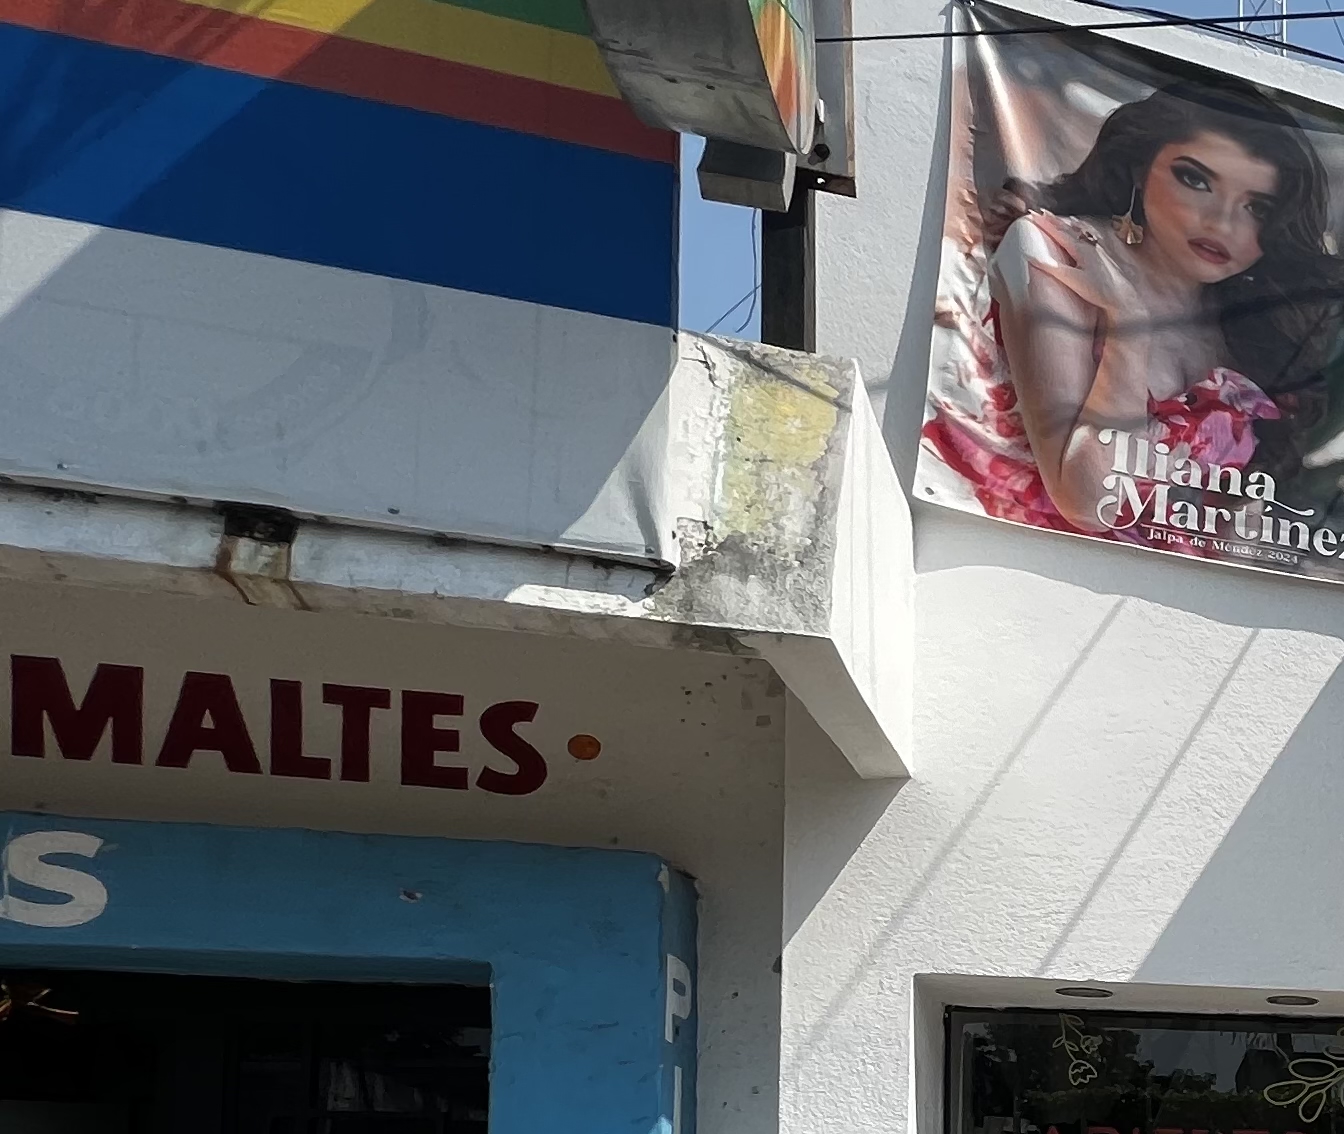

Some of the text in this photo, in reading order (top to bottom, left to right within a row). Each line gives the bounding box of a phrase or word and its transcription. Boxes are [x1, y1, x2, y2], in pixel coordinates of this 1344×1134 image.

[1098, 428, 1315, 517] Iliana
[1147, 528, 1184, 544] Jalpa
[10, 653, 548, 796] MALTES
